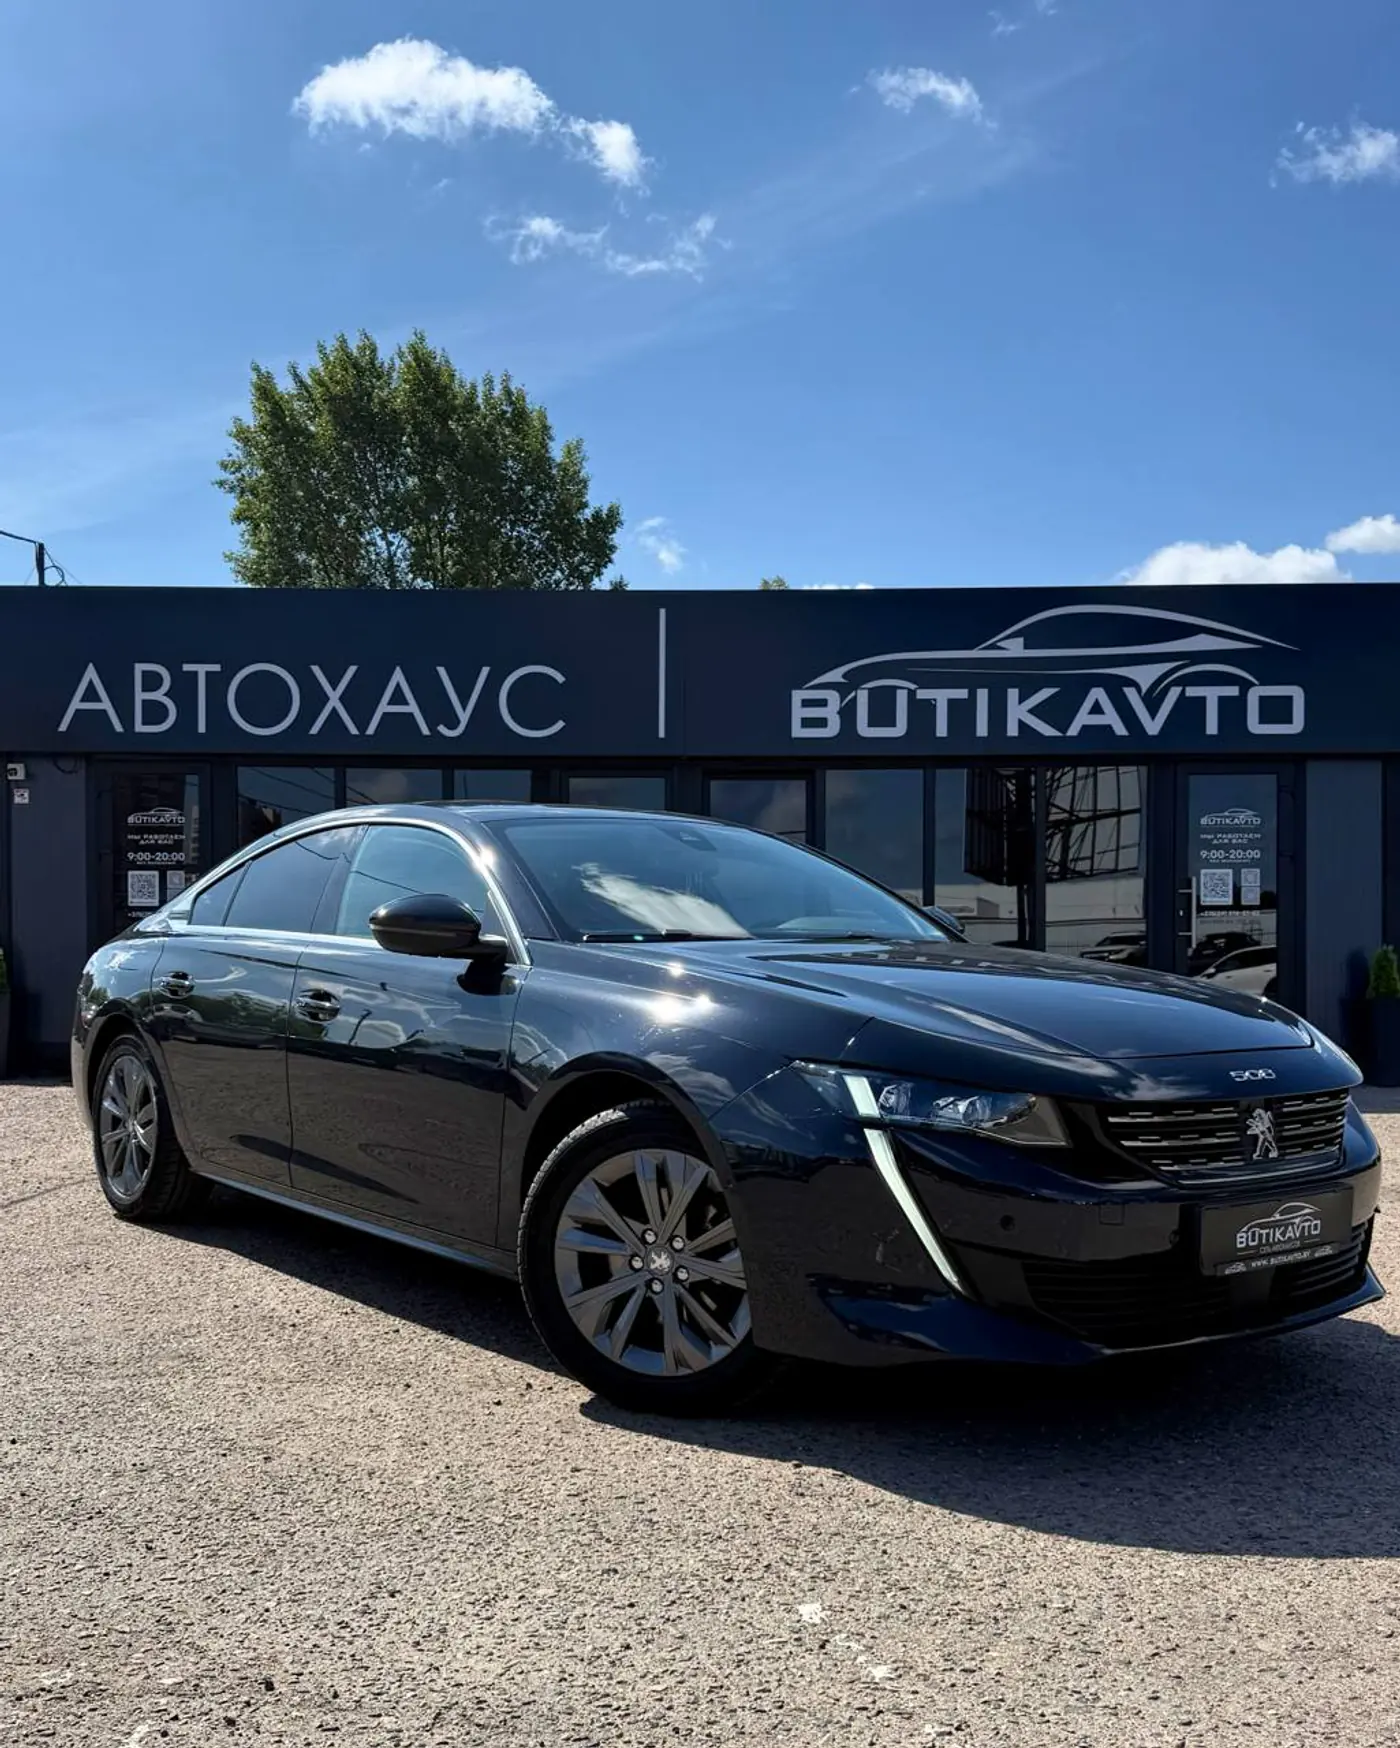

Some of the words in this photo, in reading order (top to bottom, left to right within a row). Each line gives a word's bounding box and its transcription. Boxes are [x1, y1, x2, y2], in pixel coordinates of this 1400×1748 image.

[57, 662, 567, 738] АВТОХАУС
[791, 685, 1306, 739] BUTIKAVTO
[127, 815, 186, 823] BUTIKAVTO
[1200, 816, 1261, 824] BUTIKAVTO
[127, 852, 186, 860] 9:00-20:00
[1200, 849, 1260, 858] 9:00-20:00
[1229, 1068, 1276, 1082] 508
[1236, 1219, 1322, 1248] BUTIKAVTO
